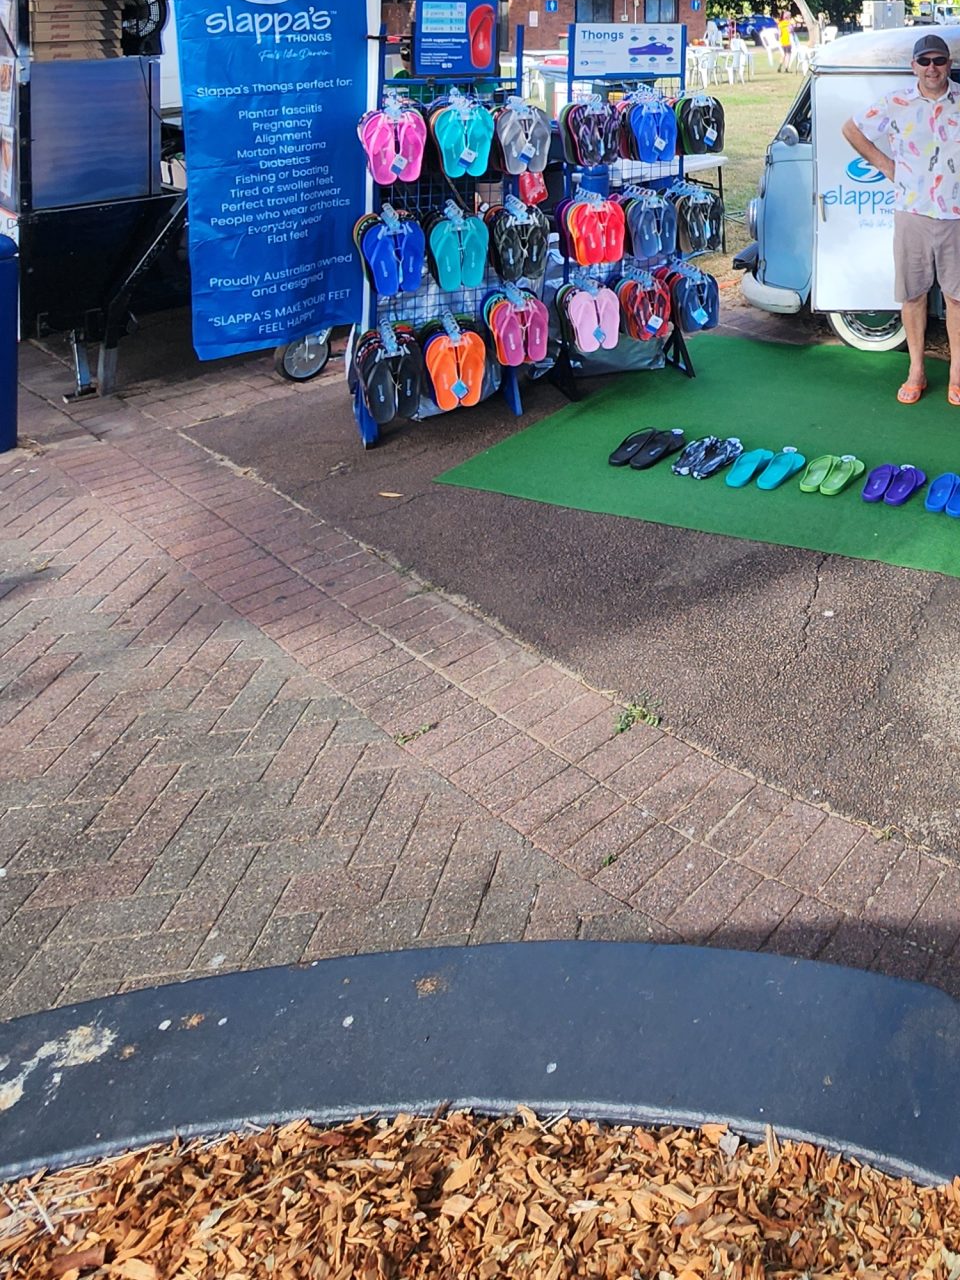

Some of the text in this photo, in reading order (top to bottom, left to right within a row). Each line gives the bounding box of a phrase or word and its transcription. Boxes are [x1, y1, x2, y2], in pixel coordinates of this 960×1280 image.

[205, 5, 331, 45] slappa's
[287, 33, 332, 43] THONGS
[581, 29, 624, 42] Thongs
[196, 77, 353, 98] Slappa's Thongs perfect for:
[238, 107, 279, 119] Plantar
[252, 118, 313, 132] Pregnancy
[255, 130, 312, 145] Alignment
[237, 141, 327, 159] Morton Neuroma
[259, 155, 311, 169] Diabetics
[235, 165, 329, 185] Fishing or boating
[230, 175, 334, 199] Tired or swollen feet
[221, 187, 341, 212] Perfect travel footwear
[824, 184, 896, 214] slappa
[210, 197, 351, 227] People who wear orthotics
[247, 213, 322, 235] Everyday wear
[267, 228, 309, 245] Flat feet
[209, 253, 353, 288] Proudly Australian owned
[251, 271, 324, 298] and designed
[274, 300, 301, 317] MAKE
[302, 293, 326, 308] YOUR
[328, 288, 351, 301] FEET
[258, 323, 285, 335] FEEL
